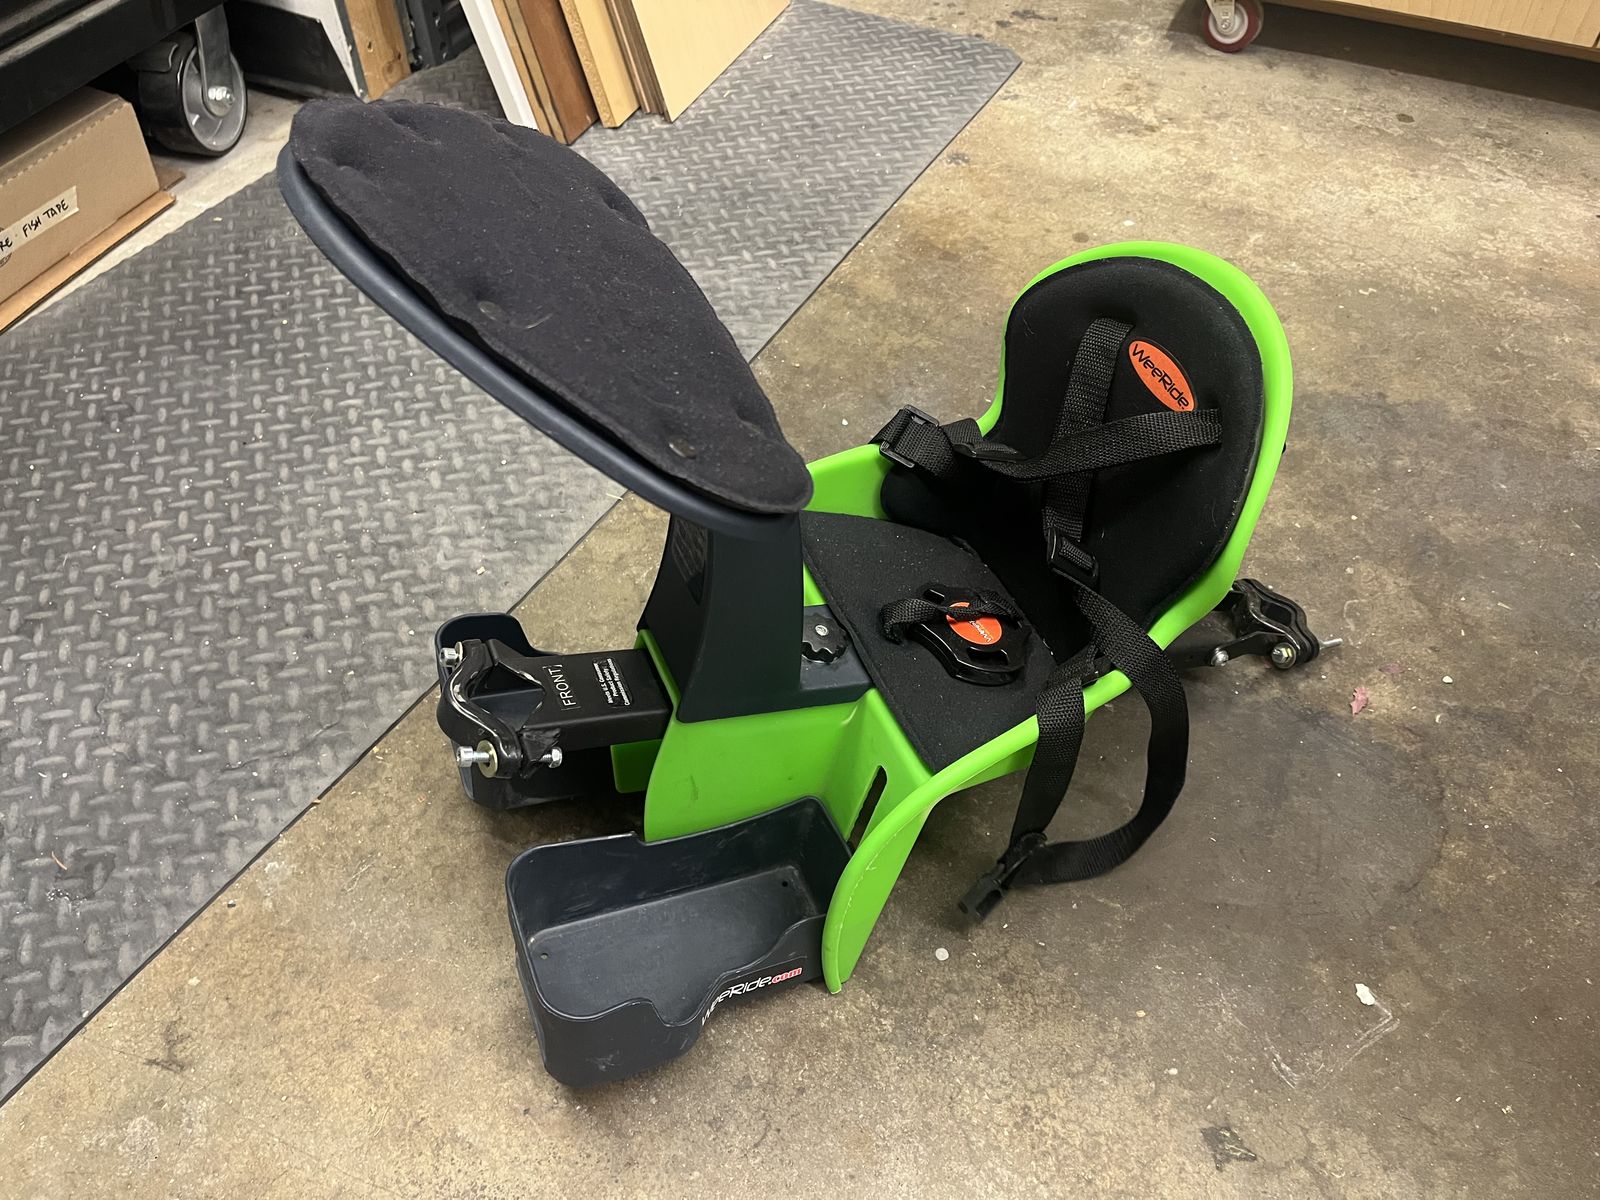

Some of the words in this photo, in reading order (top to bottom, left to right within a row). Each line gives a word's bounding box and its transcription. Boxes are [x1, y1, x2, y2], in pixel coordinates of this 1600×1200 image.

[22, 215, 42, 238] FISH
[42, 199, 69, 219] TAPE
[548, 668, 577, 706] FRONT
